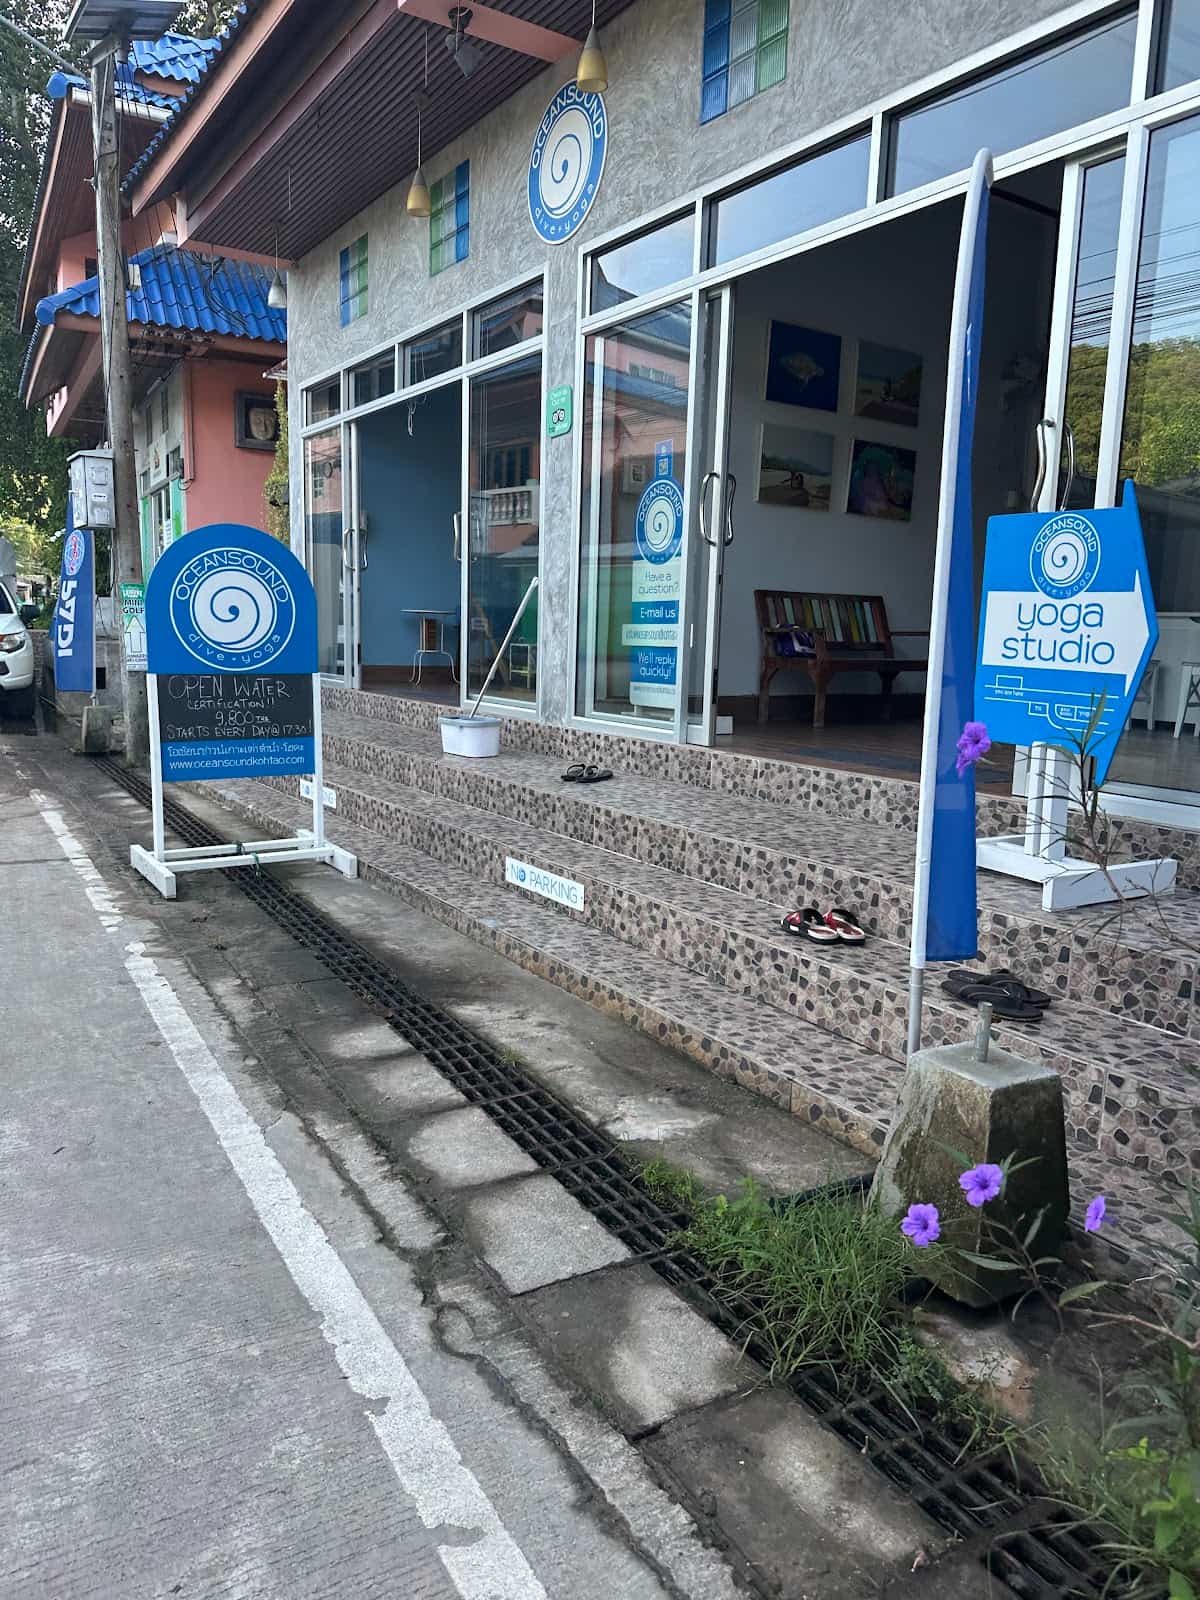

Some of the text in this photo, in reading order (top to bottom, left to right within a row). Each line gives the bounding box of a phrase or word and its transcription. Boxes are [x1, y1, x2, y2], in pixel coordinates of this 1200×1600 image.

[532, 85, 604, 169] OCEANSOUND
[639, 484, 682, 522] OCEANSOUND
[1034, 518, 1097, 553] OCEANSOUND
[175, 551, 289, 602] OCEANSOUND
[122, 606, 145, 614] GOLF
[124, 599, 143, 607] MINI
[640, 607, 676, 619] E-mail us
[1017, 602, 1104, 634] yoga
[188, 633, 281, 664] dive yoga
[654, 653, 676, 667] reply
[1001, 633, 1115, 665] studio
[167, 675, 223, 700] OPEN
[215, 726, 246, 738] EVERY
[169, 756, 305, 770] www.oceansoundkohtao.com
[511, 865, 578, 904] NO PARKING
